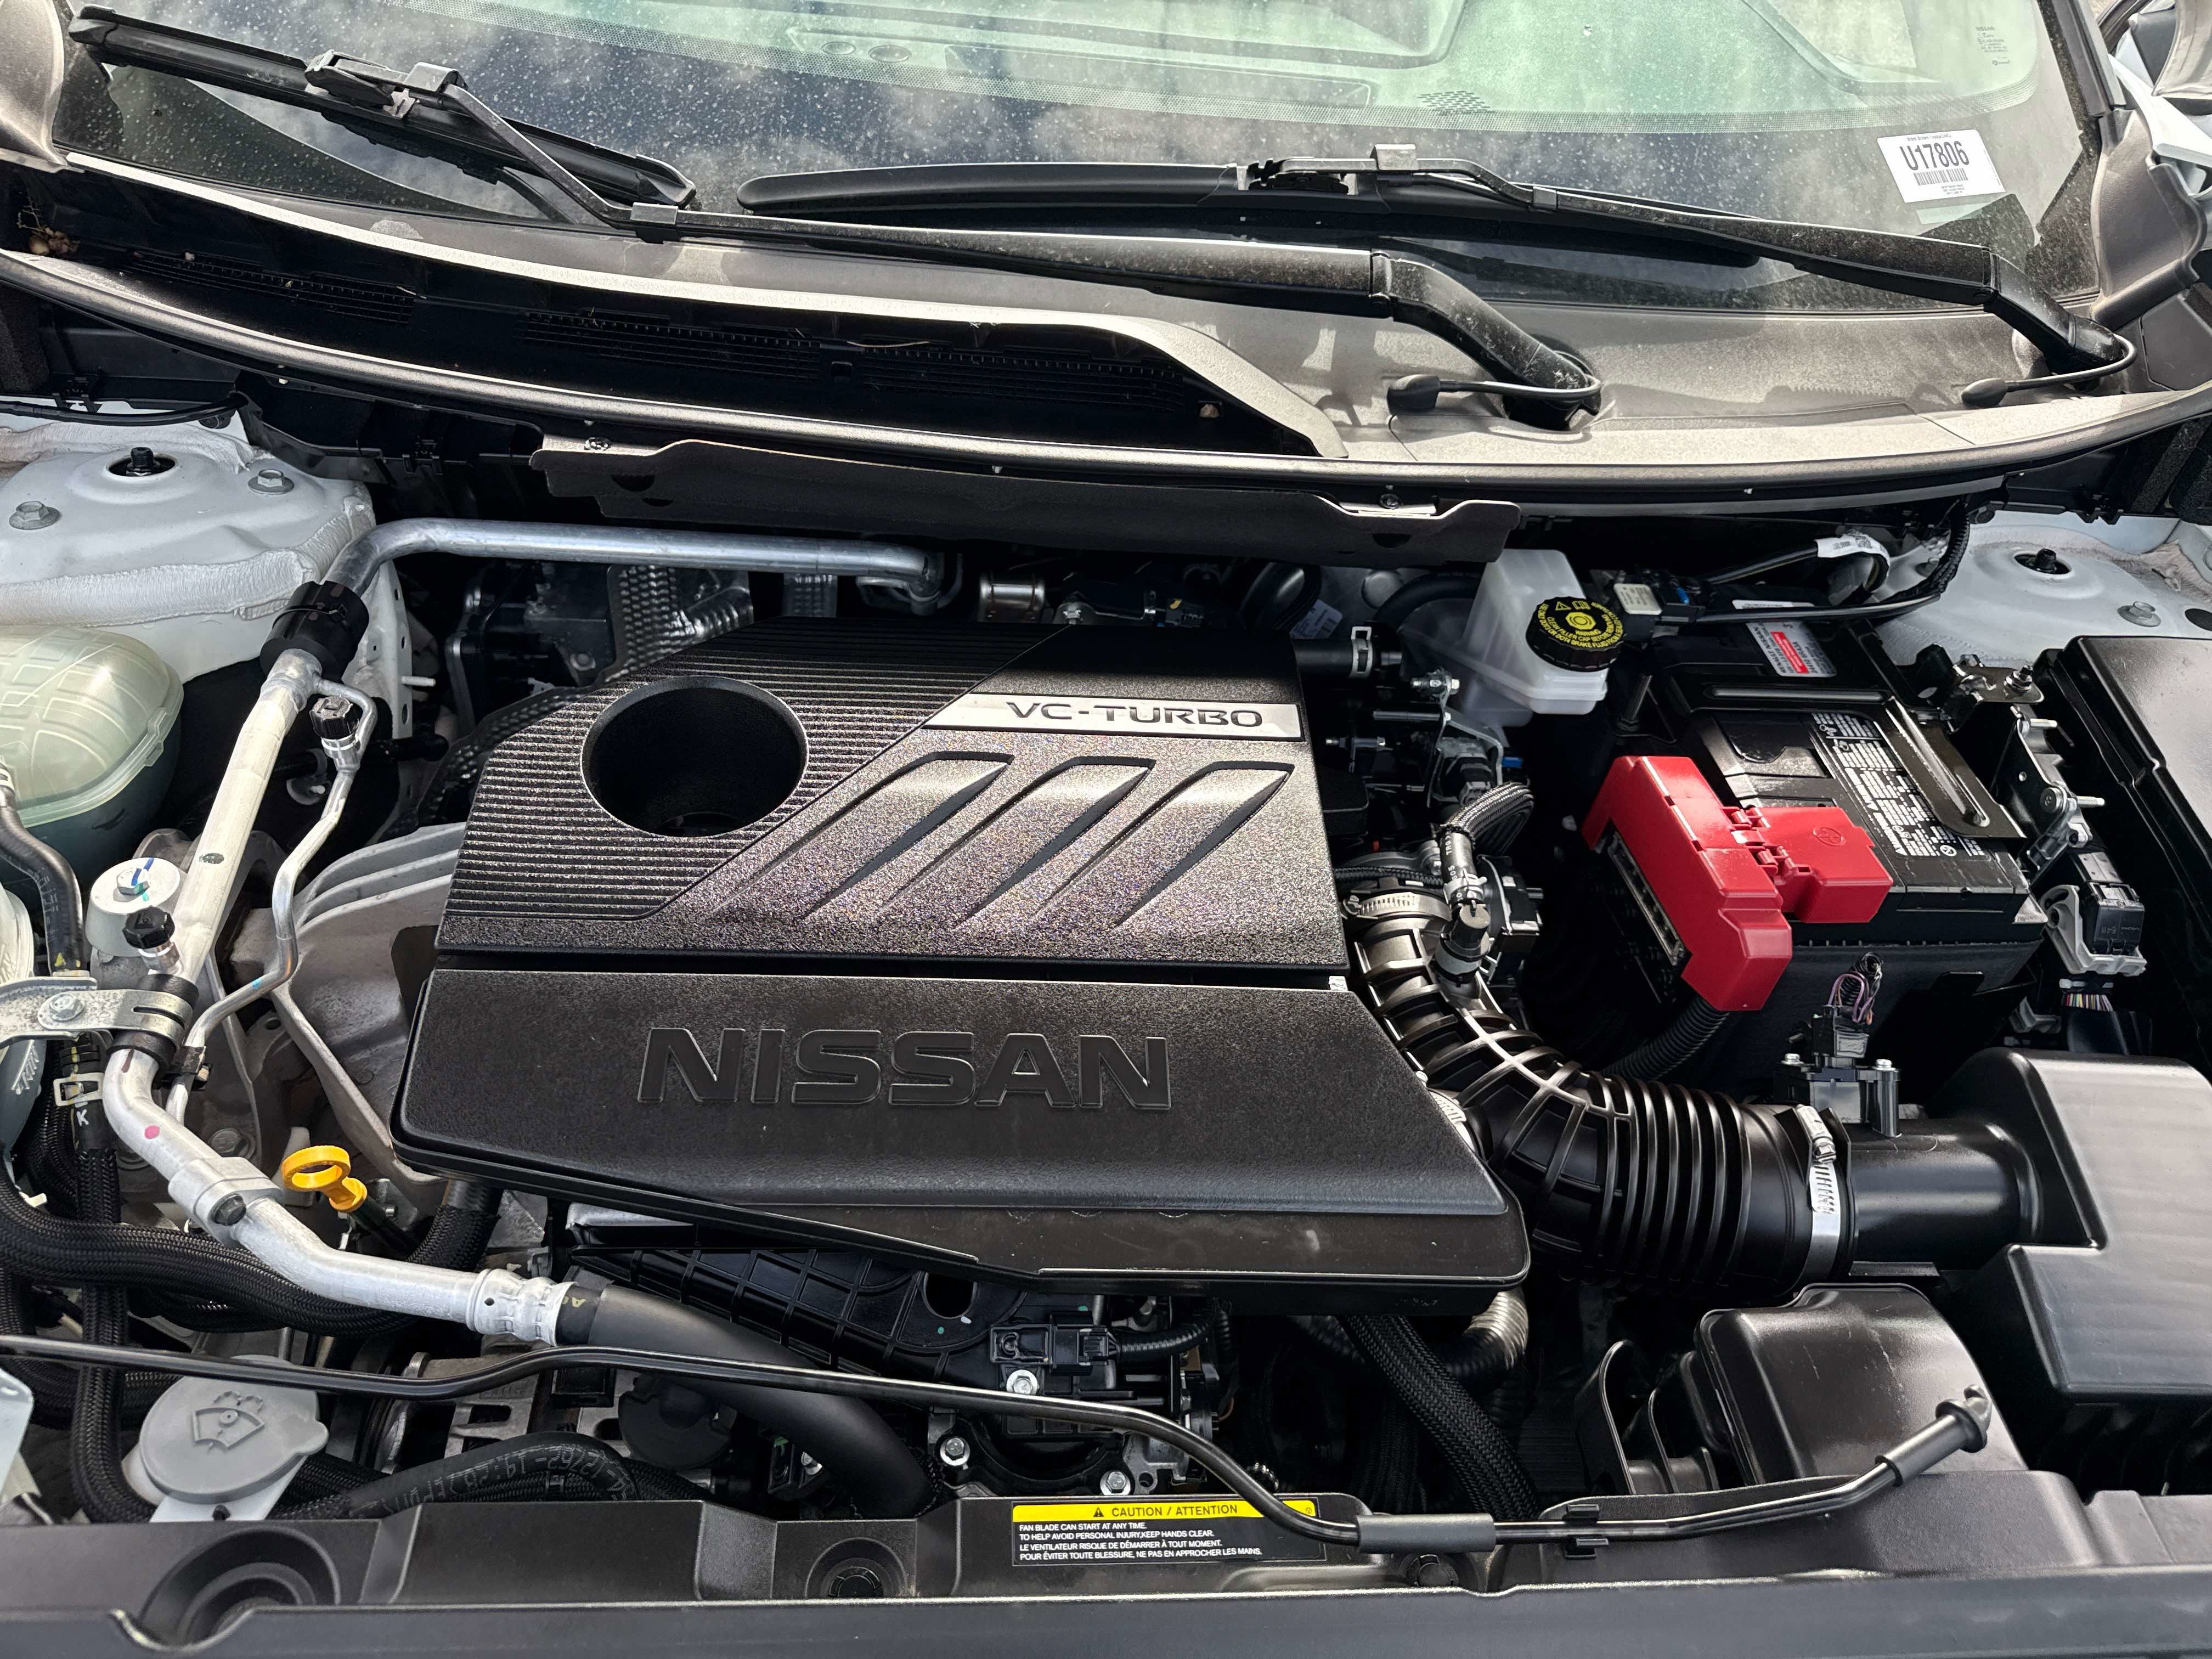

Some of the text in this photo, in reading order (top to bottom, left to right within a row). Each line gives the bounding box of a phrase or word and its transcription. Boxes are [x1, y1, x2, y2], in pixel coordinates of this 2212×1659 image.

[1899, 141, 1970, 170] U17806
[1558, 628, 1578, 640] FILLER
[1571, 639, 1592, 648] BRAKE
[1006, 701, 1263, 729] VC-TURBO
[637, 1027, 1172, 1109] NISSAN
[1111, 1504, 1237, 1517] CAUTION / ATTENTION
[1030, 1543, 1078, 1551] VENTILATEUR
[1120, 1540, 1160, 1549] DÉMARRER
[1161, 1539, 1168, 1548] À
[1043, 1551, 1068, 1560] ÉVITER
[1094, 1551, 1135, 1559] BLESSURE,
[1175, 1549, 1222, 1557] APPROCHER
